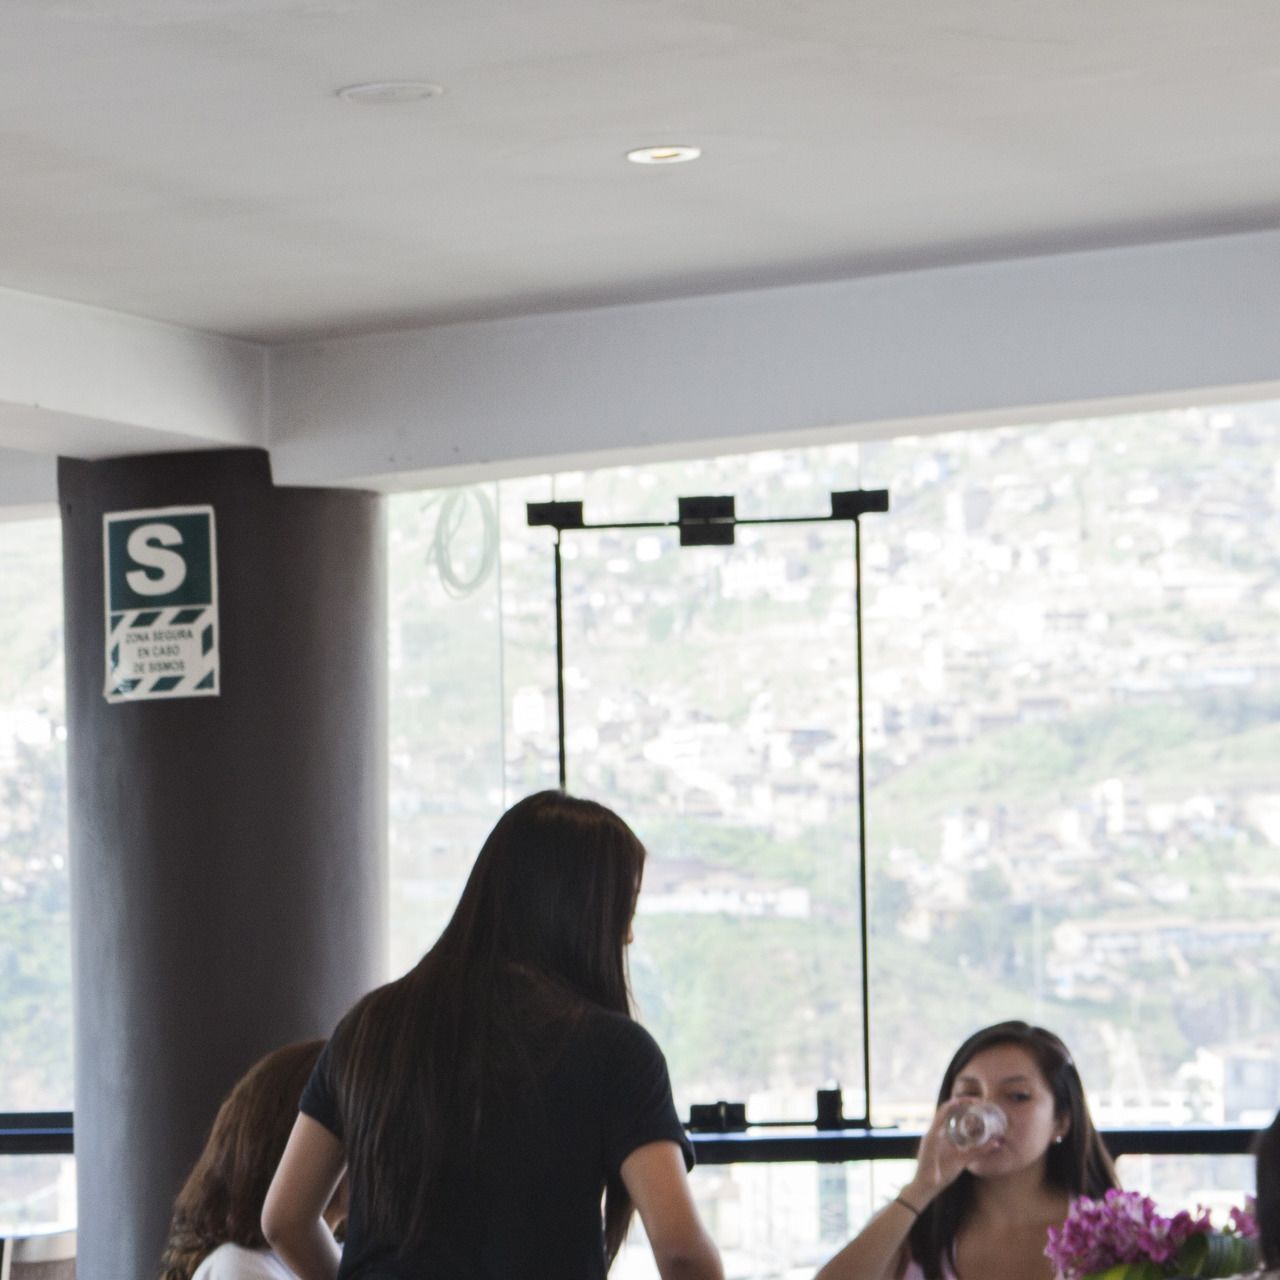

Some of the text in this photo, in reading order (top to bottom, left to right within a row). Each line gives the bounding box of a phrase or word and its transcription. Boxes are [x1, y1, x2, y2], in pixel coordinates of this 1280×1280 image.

[125, 523, 187, 596] S
[126, 629, 193, 643] ZONA SEGURA
[138, 646, 150, 657] EN
[133, 660, 185, 674] DE SISMOS
